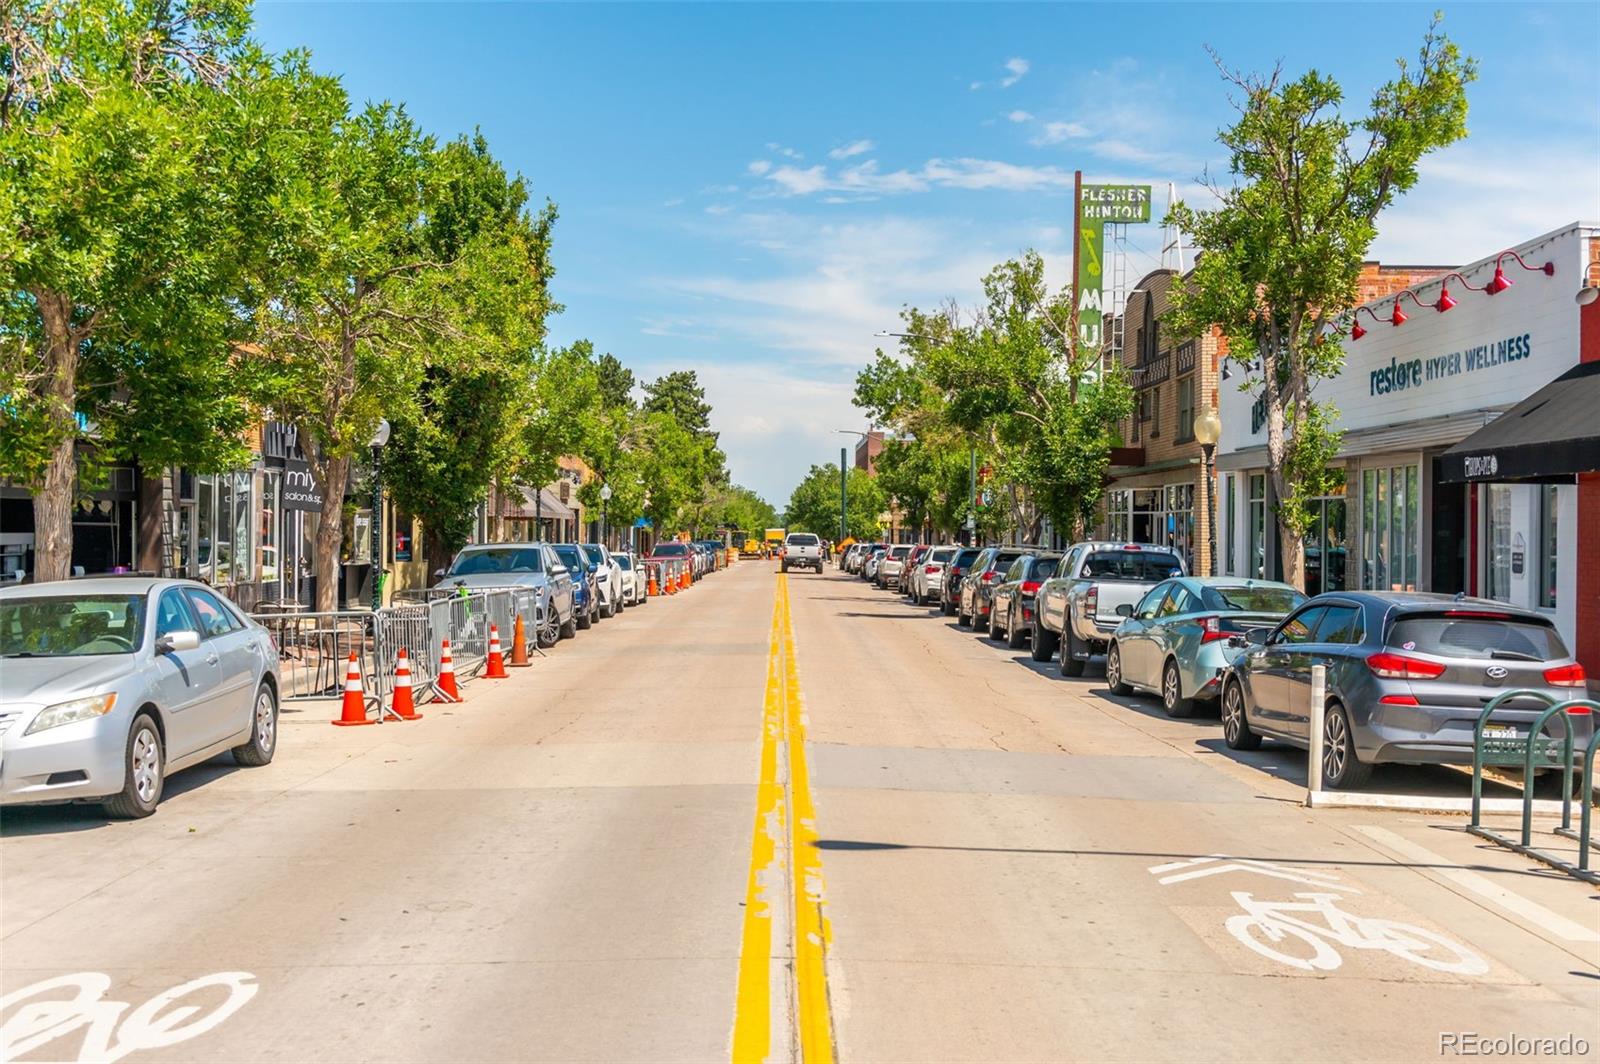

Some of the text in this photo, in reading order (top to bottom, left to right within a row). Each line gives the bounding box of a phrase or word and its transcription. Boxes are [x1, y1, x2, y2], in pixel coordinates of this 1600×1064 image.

[1081, 189, 1146, 201] FLESHER
[1085, 205, 1142, 218] HINTON
[1370, 333, 1530, 396] restore HYPER WELLNESS
